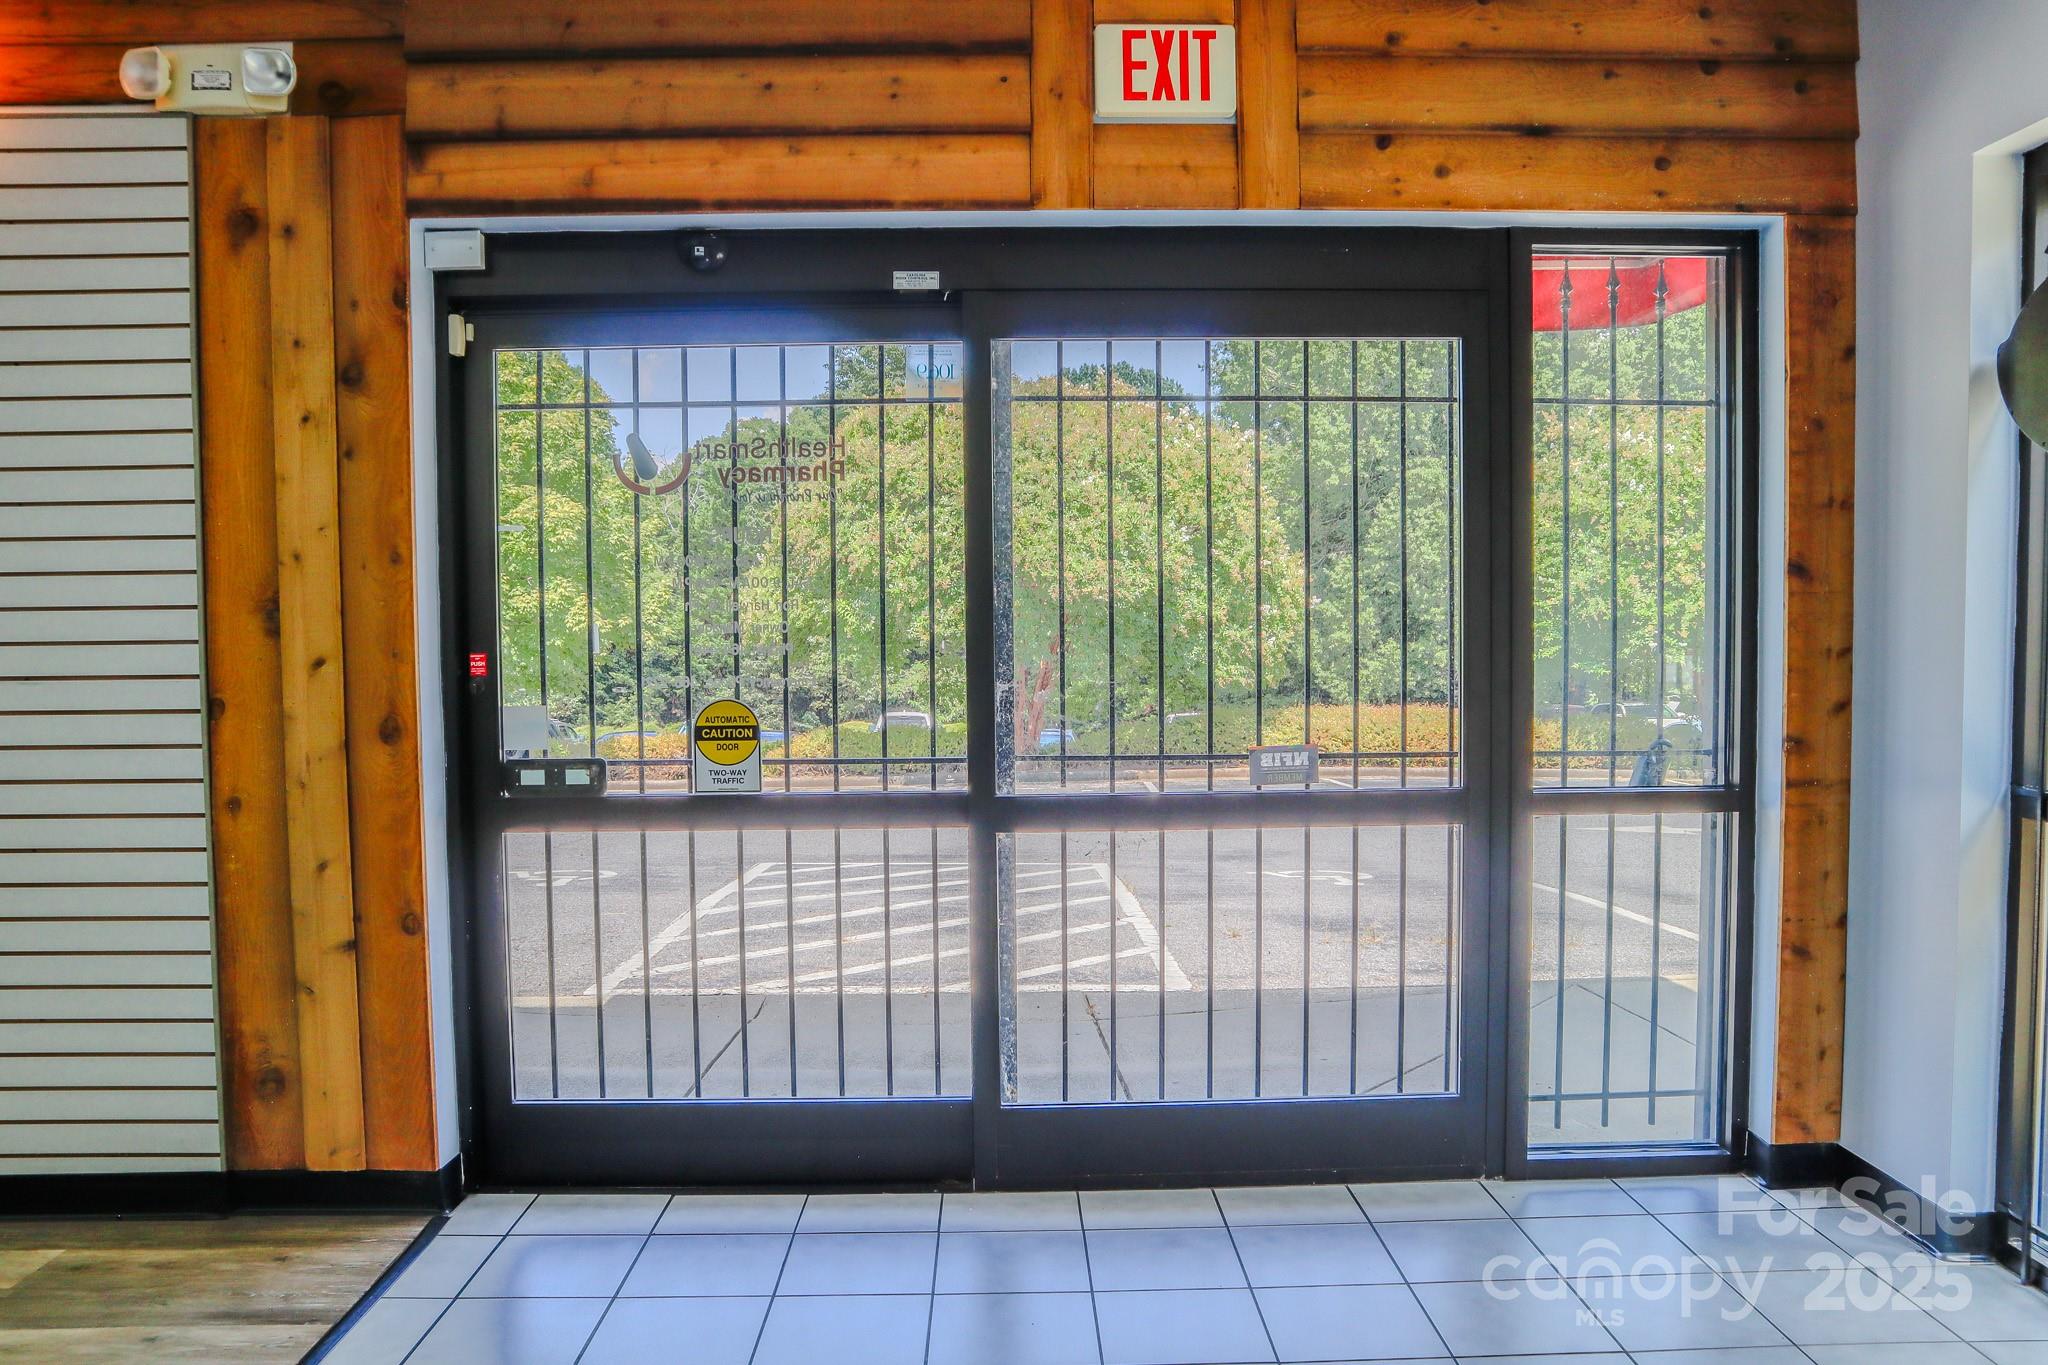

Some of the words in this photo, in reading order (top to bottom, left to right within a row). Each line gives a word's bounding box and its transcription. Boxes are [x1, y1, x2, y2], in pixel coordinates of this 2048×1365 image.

[1121, 29, 1217, 102] EXIT
[704, 715, 750, 724] AUTOMATIC
[701, 728, 753, 738] CAUTION
[716, 743, 739, 751] DOOR
[708, 769, 748, 777] TWO-WAY
[711, 777, 745, 785] TRAFFIC
